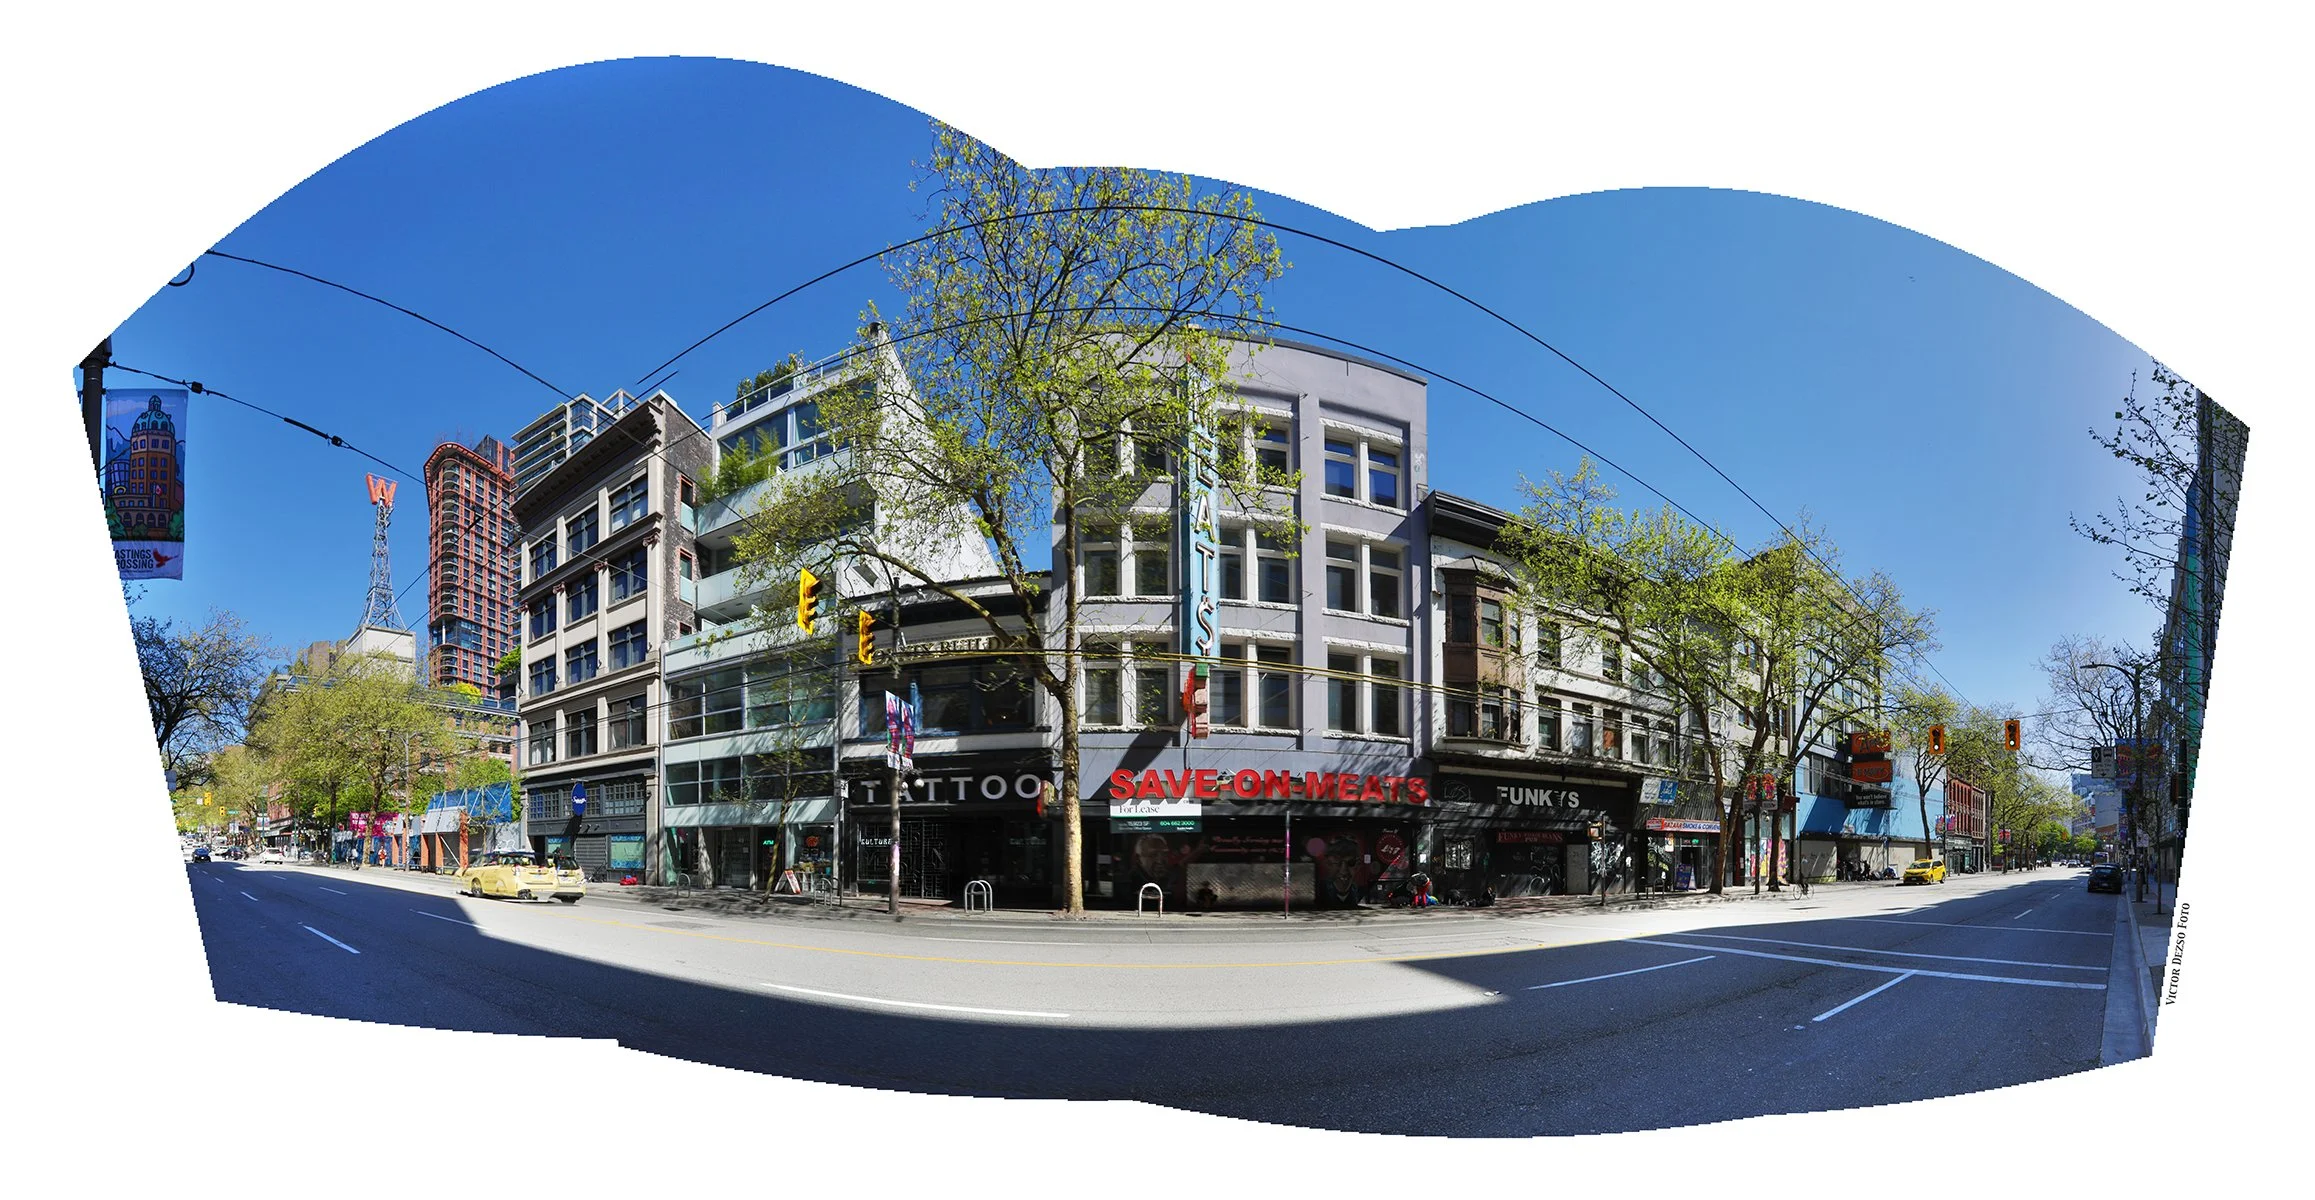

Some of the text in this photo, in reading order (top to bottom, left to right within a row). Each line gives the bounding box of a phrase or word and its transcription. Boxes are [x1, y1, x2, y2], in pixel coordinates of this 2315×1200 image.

[366, 473, 397, 507] W
[114, 549, 152, 559] ASTINGS
[860, 774, 1042, 803] TATTOO
[1109, 769, 1430, 804] SAVE-ON-MEATS
[1497, 786, 1580, 808] FUNKYS
[1119, 805, 1160, 813] For Lease
